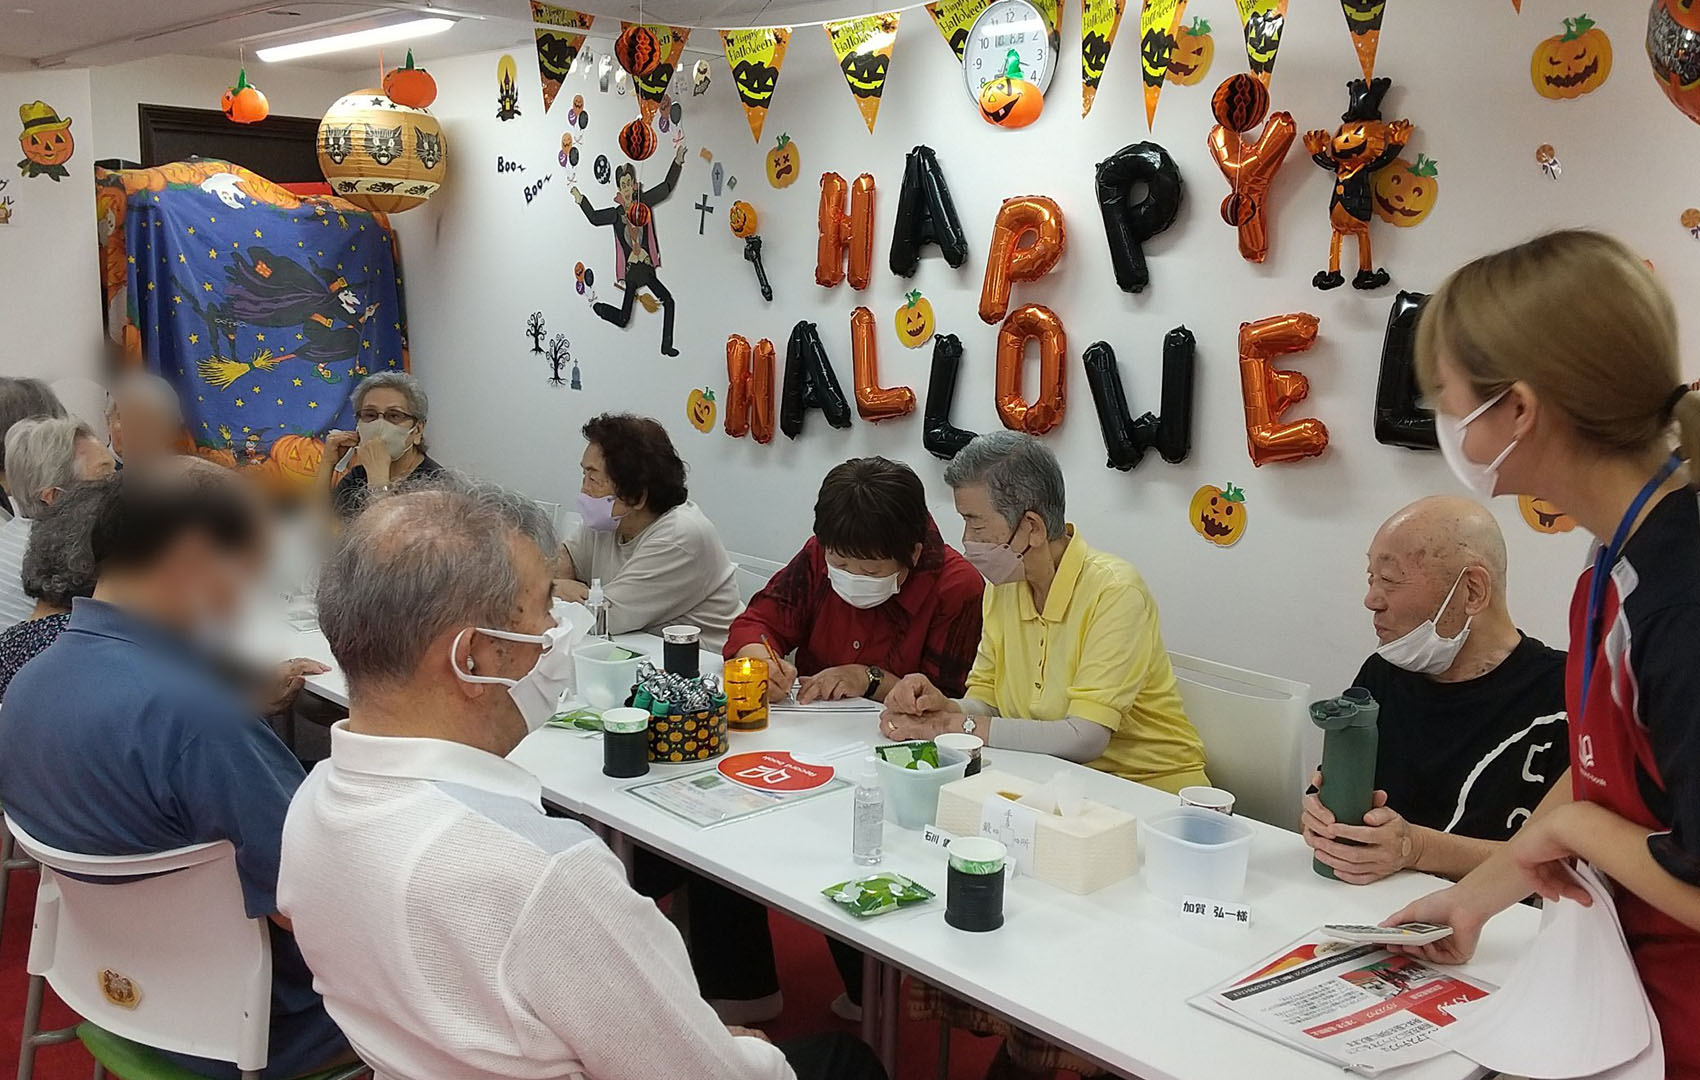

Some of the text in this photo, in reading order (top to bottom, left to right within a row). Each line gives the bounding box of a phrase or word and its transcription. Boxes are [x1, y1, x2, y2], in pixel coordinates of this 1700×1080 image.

[939, 0, 987, 33] Halloween
[1006, 11, 1015, 24] 12
[736, 31, 758, 44] Happy
[980, 37, 989, 49] 10
[728, 39, 773, 62] Halloween
[1037, 49, 1043, 60] 3
[975, 58, 982, 70] 9
[1030, 70, 1037, 81] 4
[815, 111, 1297, 325] HAPPY
[925, 830, 940, 845] 石川
[1183, 901, 1248, 922] 加賀 弘一様
